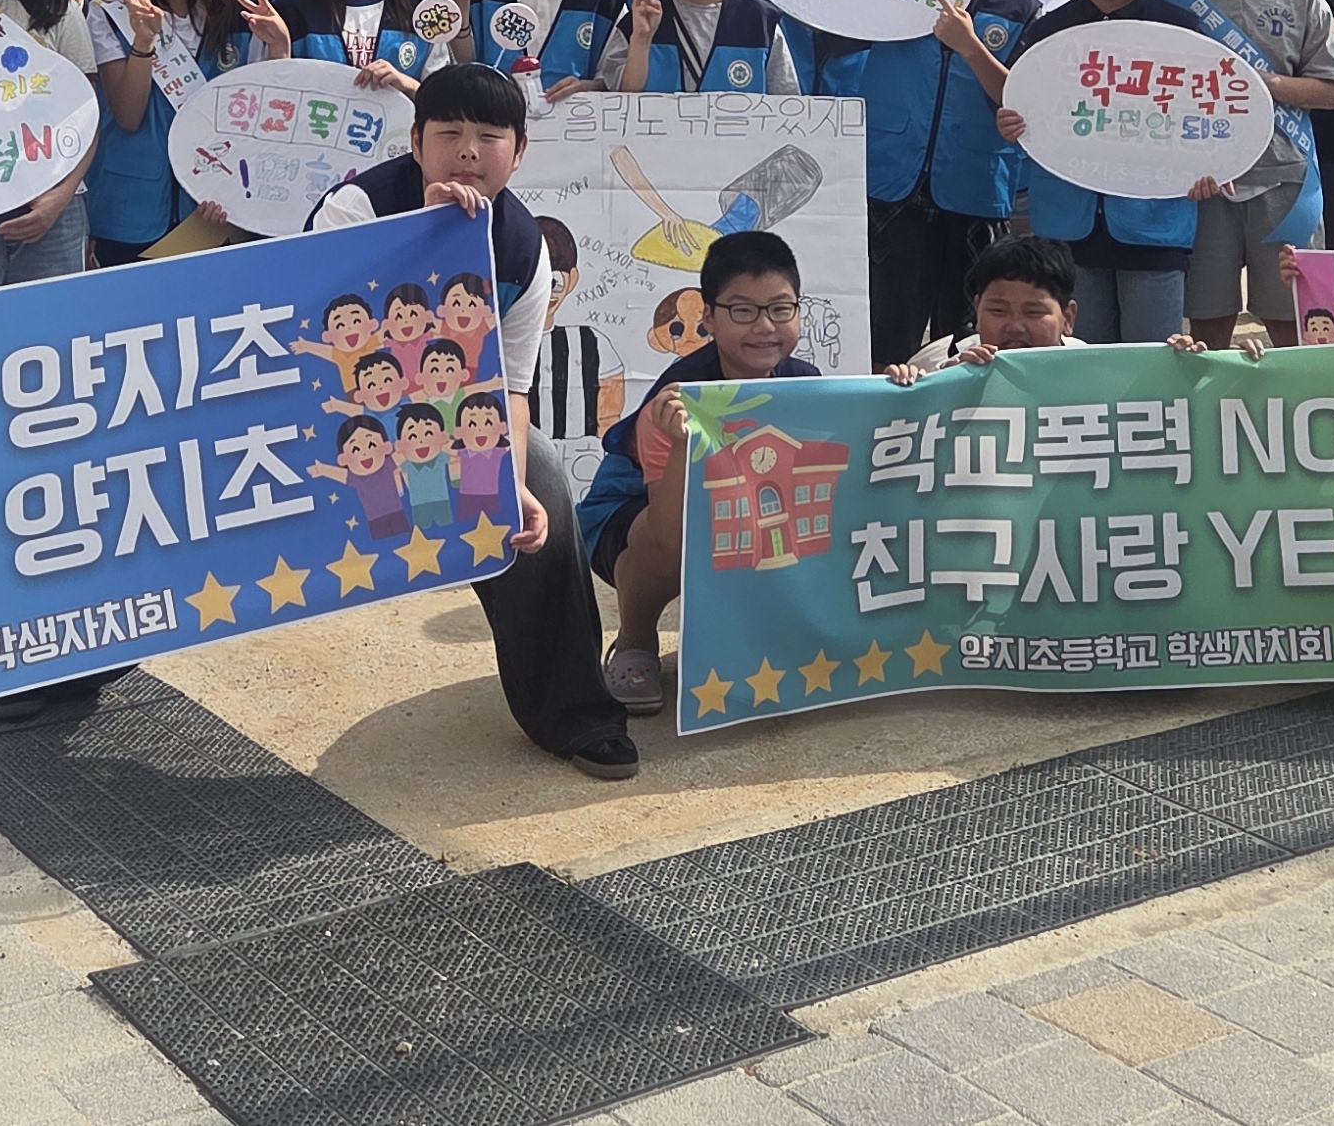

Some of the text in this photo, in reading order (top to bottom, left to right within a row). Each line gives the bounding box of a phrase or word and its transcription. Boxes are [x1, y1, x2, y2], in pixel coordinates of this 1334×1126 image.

[420, 4, 449, 23] 약속
[422, 18, 451, 39] 해요
[503, 9, 528, 31] 친구
[503, 27, 532, 46] 사랑
[2, 303, 302, 449] 양지초
[869, 397, 1193, 493] 학교폭력
[4, 423, 315, 577] 양지초
[850, 511, 1190, 614] 친구사랑
[959, 625, 1334, 673] 양지초등학교 학생자치회
